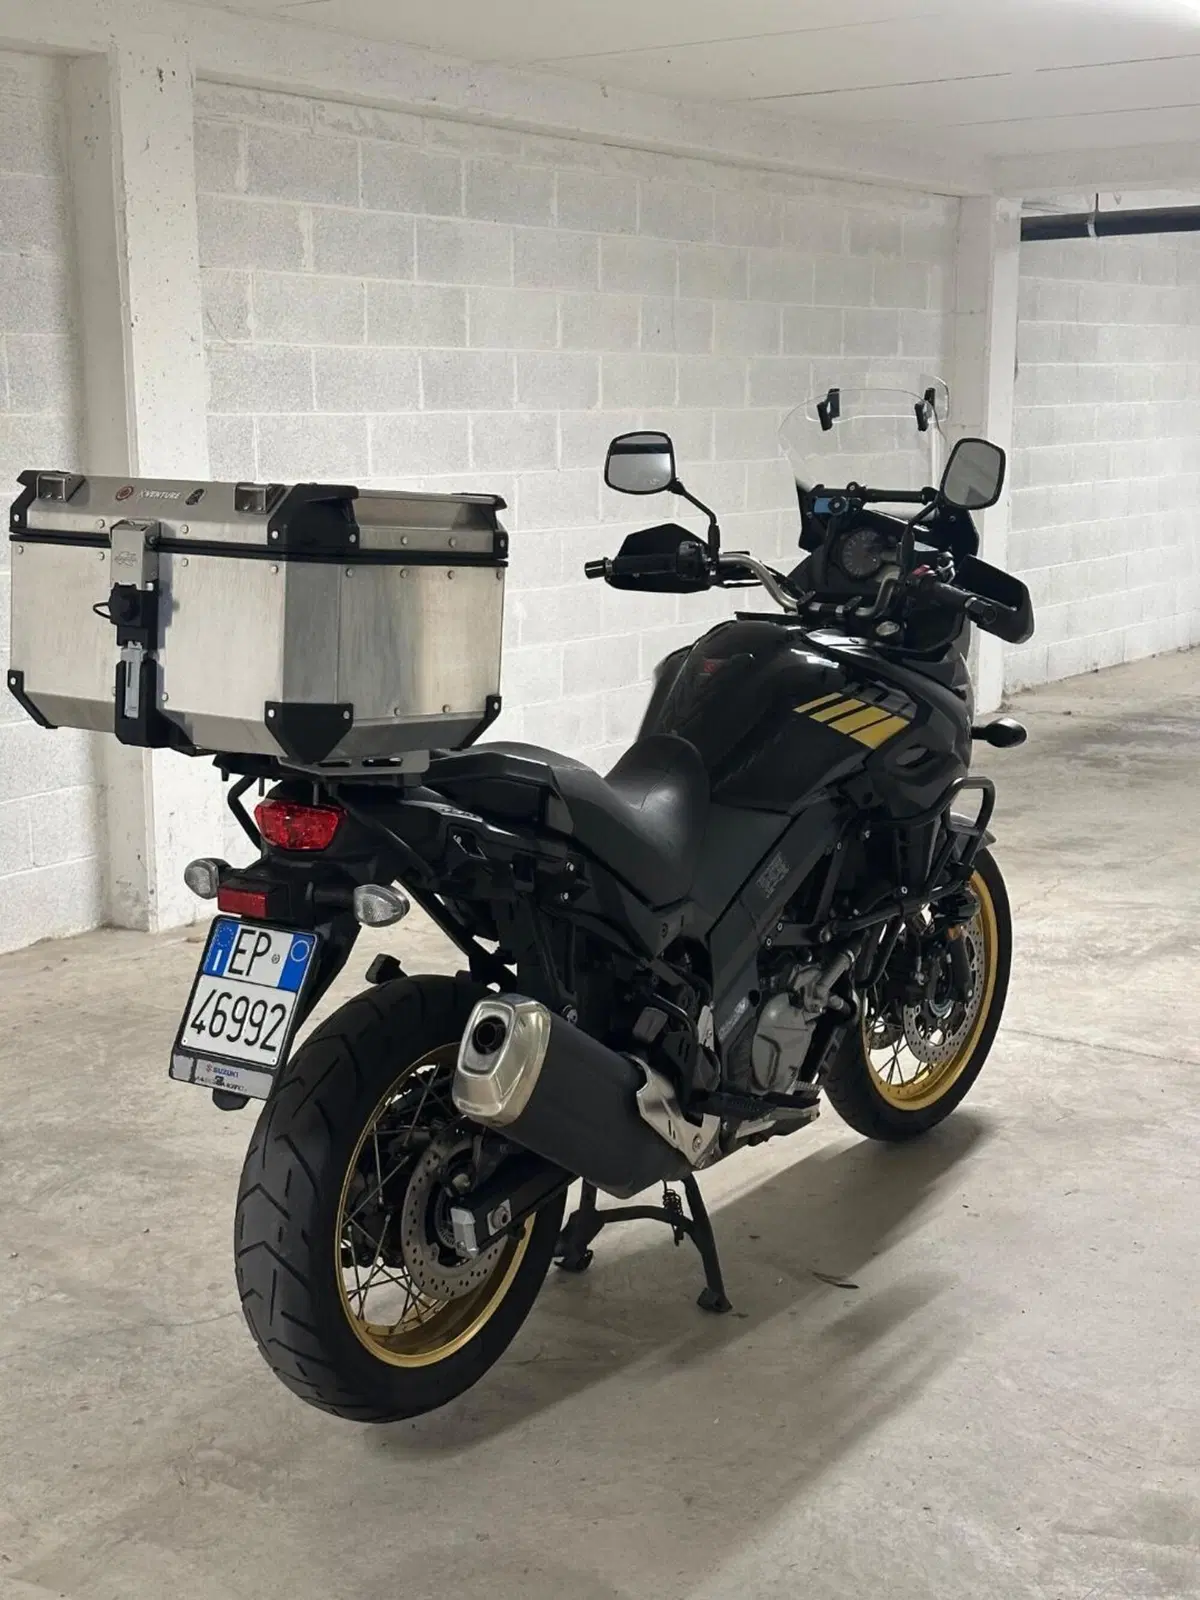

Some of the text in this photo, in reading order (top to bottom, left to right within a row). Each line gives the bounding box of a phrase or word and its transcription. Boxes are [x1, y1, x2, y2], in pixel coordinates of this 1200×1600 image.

[212, 928, 272, 977] I EP
[190, 988, 287, 1053] 46992
[212, 1066, 239, 1078] SUZUKI
